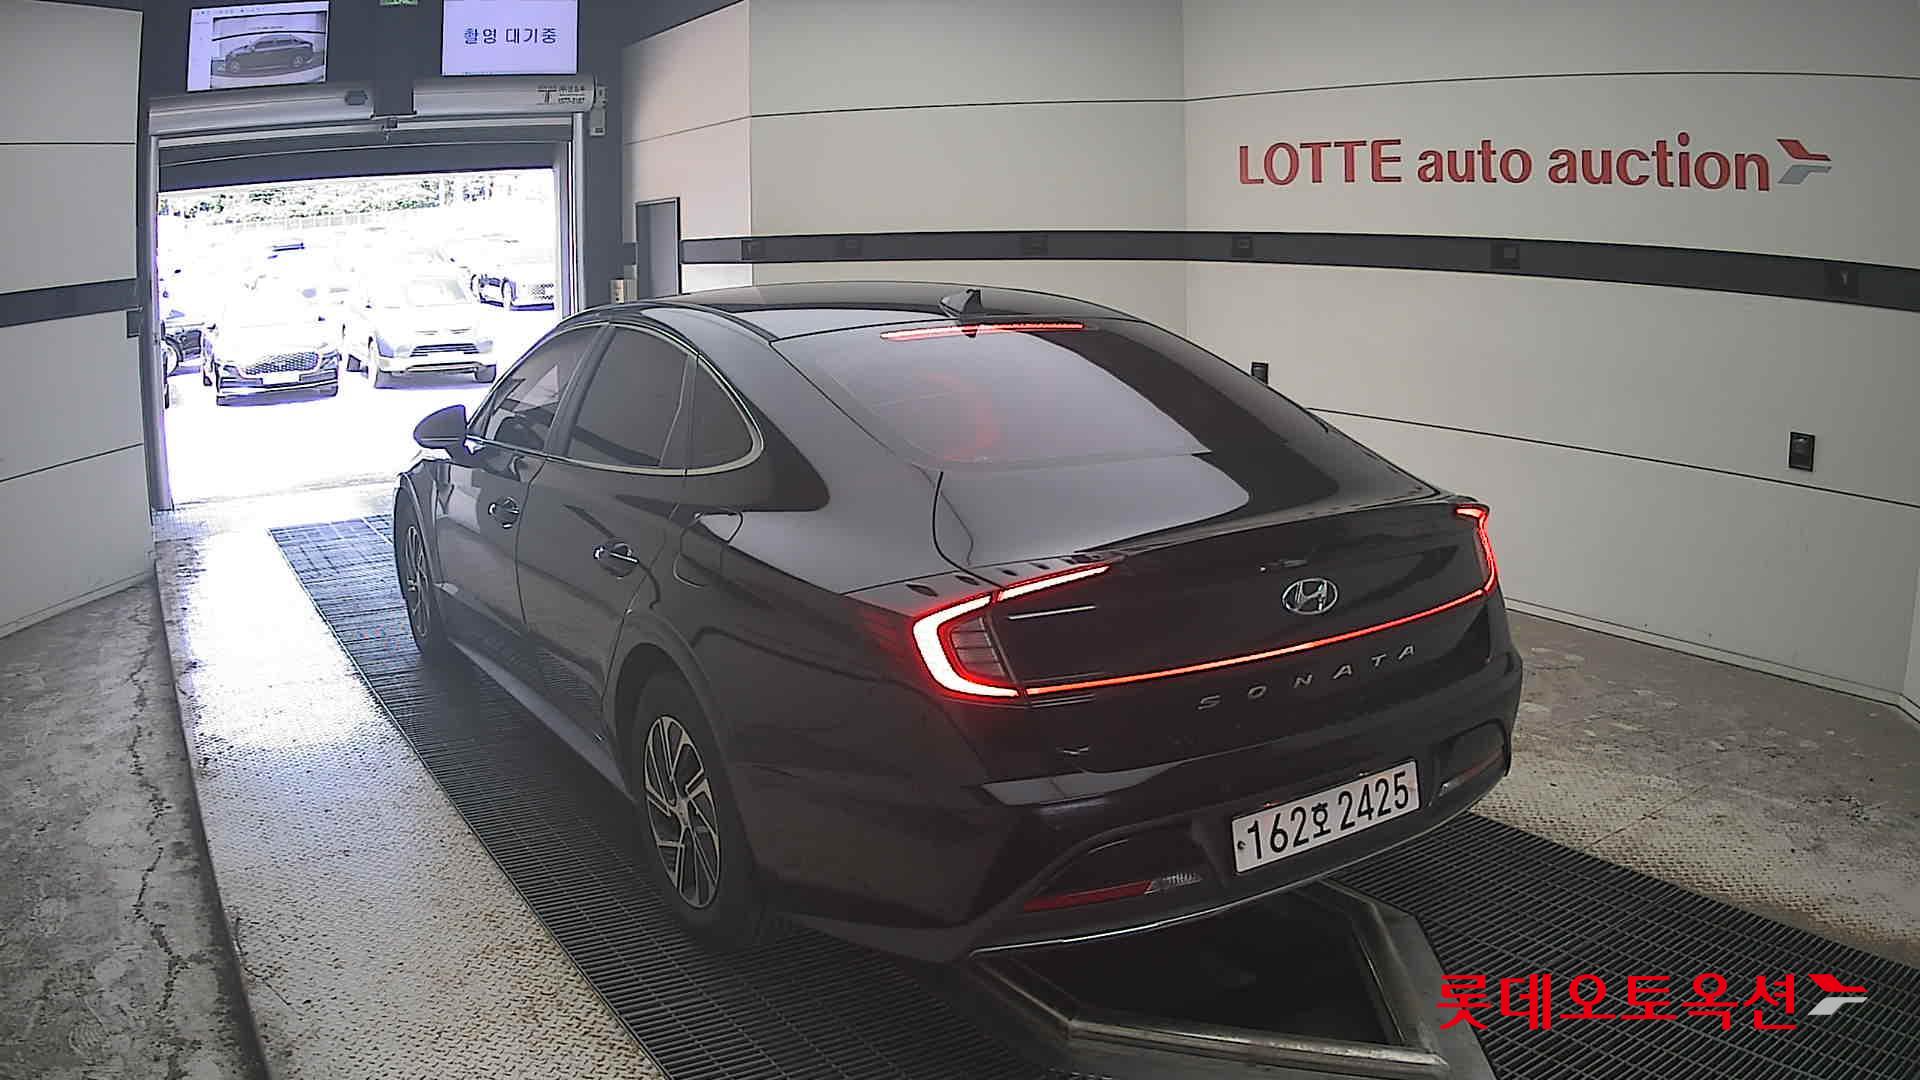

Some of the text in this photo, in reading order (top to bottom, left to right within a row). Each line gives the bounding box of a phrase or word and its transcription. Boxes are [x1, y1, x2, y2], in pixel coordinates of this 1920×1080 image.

[505, 27, 556, 44] 대기중
[1239, 131, 1770, 191] LOTTE auto auction
[1197, 643, 1416, 711] SONATA
